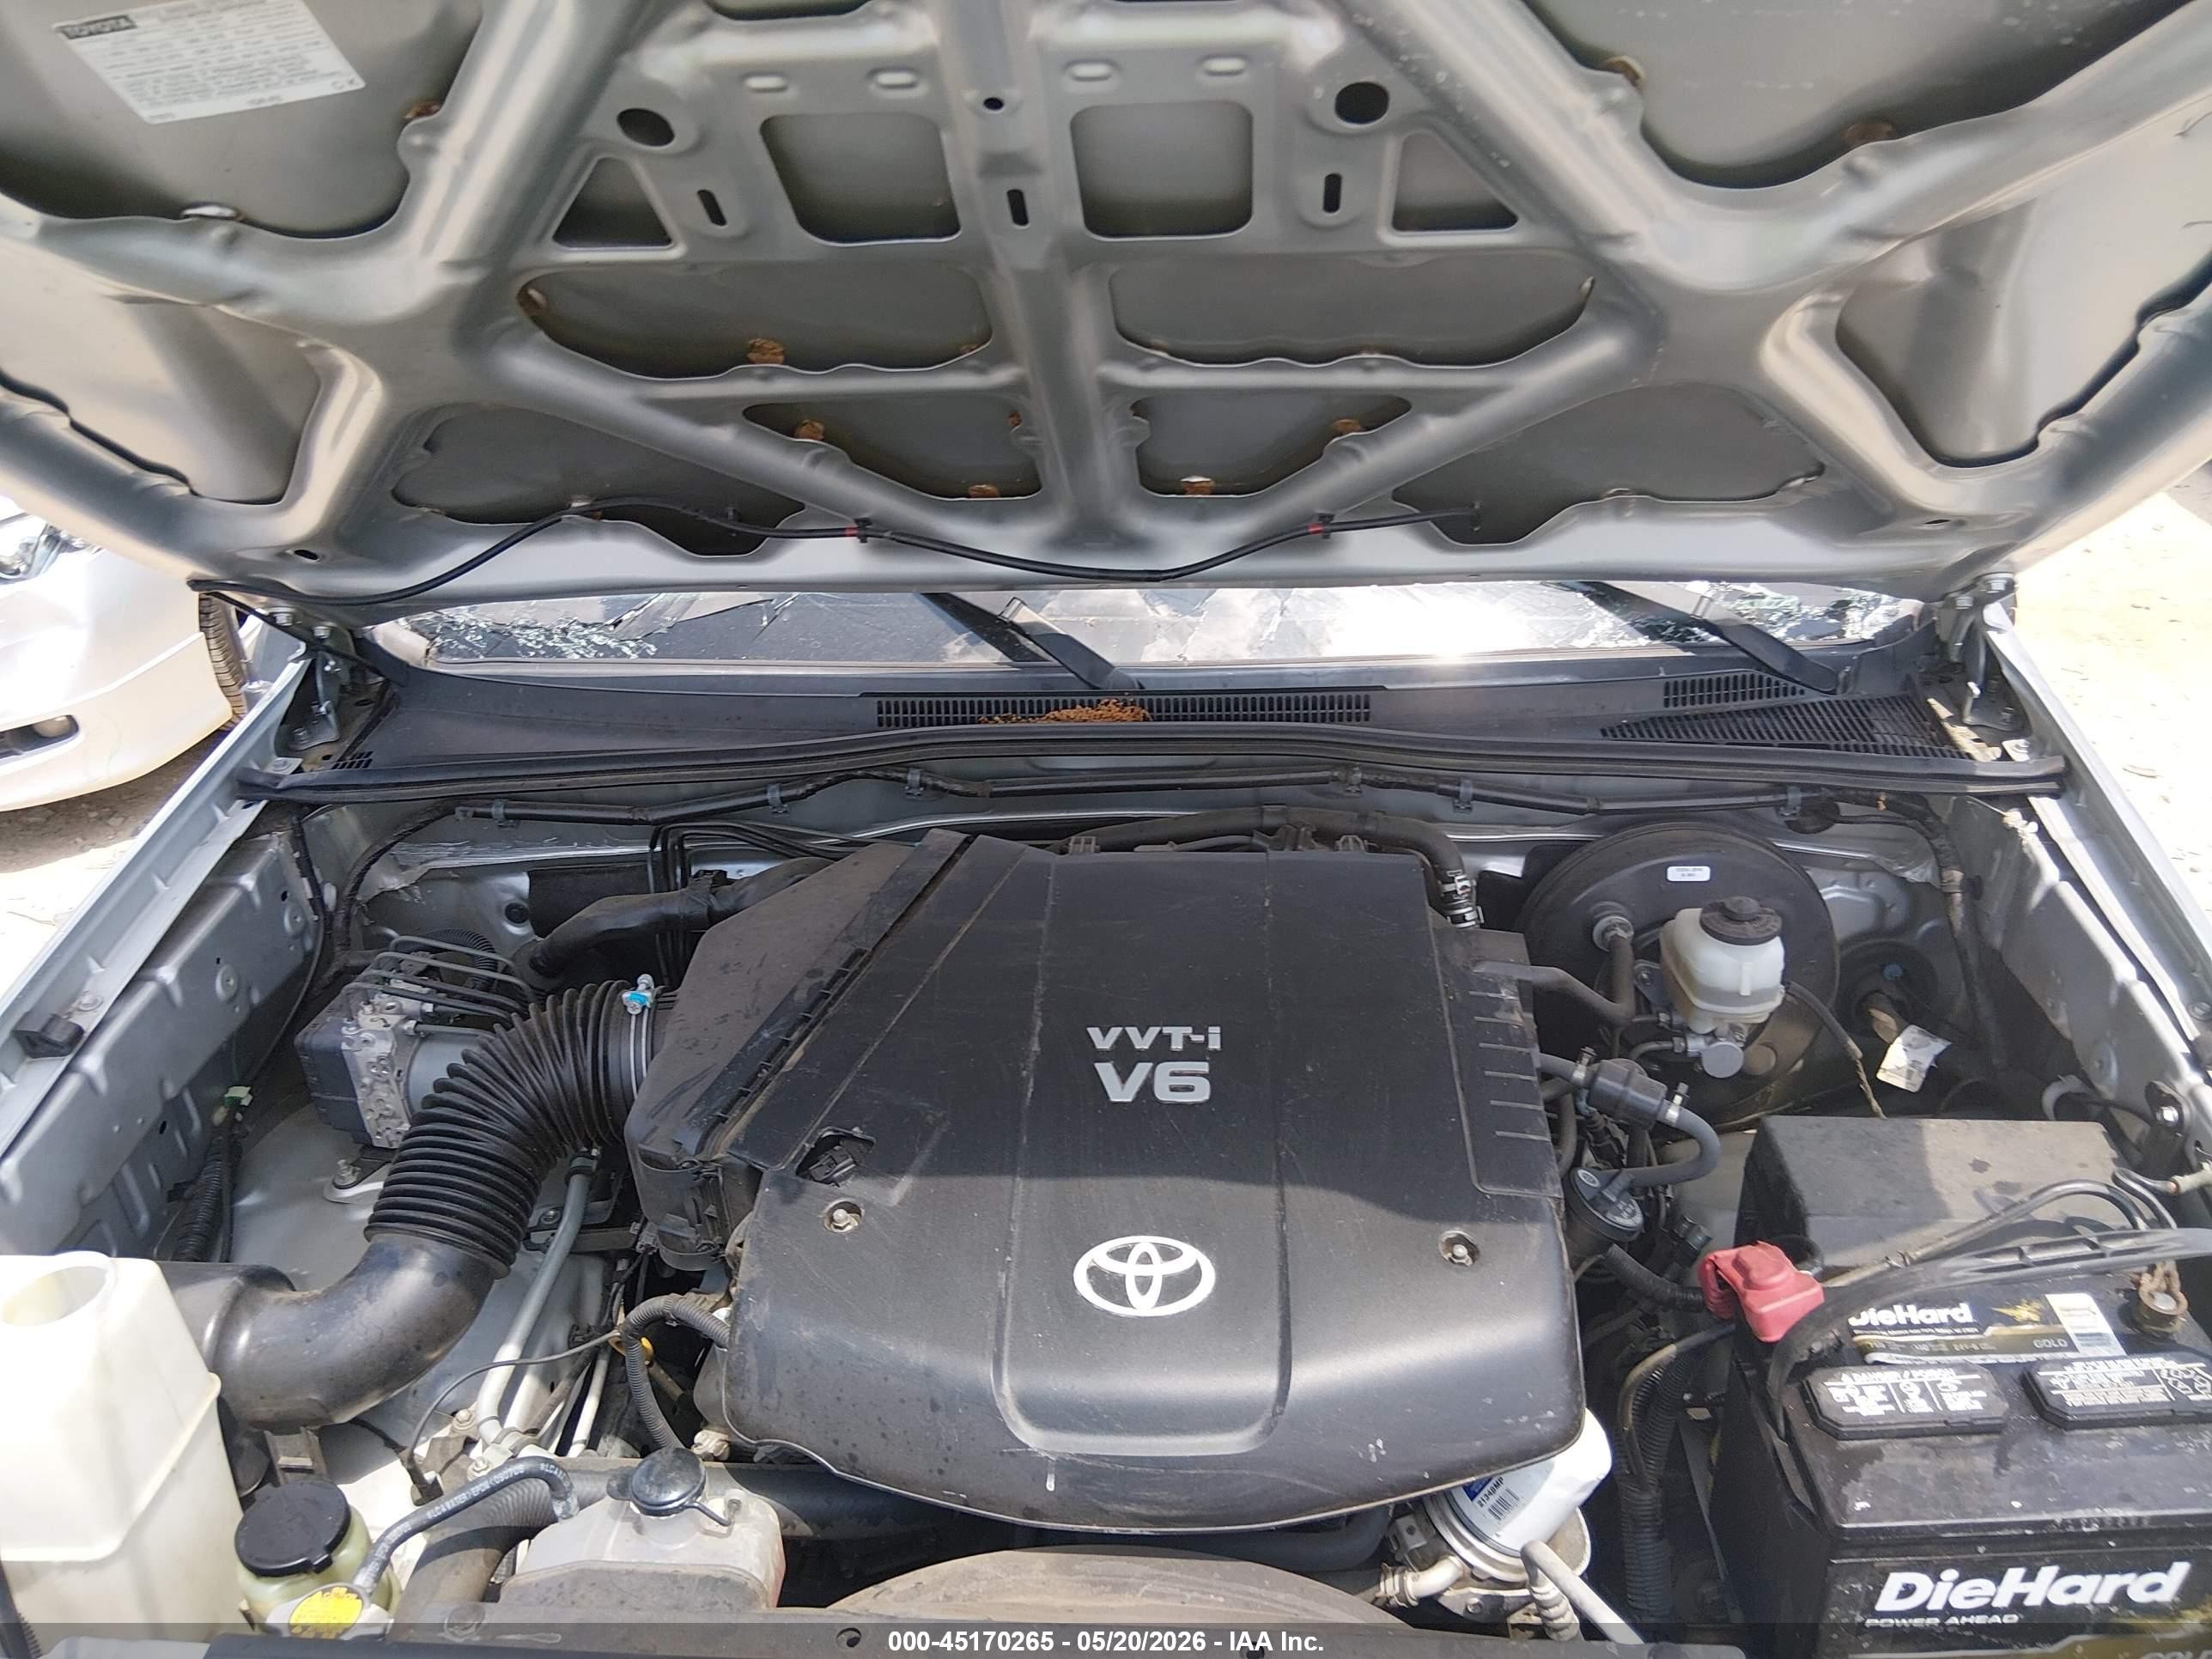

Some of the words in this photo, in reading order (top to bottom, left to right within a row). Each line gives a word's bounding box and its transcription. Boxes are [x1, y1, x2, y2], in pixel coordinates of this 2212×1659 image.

[1086, 1026, 1222, 1051] VVT-i
[1094, 1061, 1212, 1103] V6
[2033, 1339, 2069, 1349] GOLD
[1875, 1561, 2192, 1612] DieHard
[1864, 1617, 1940, 1628] POWER
[1944, 1613, 2020, 1625] AHEAD
